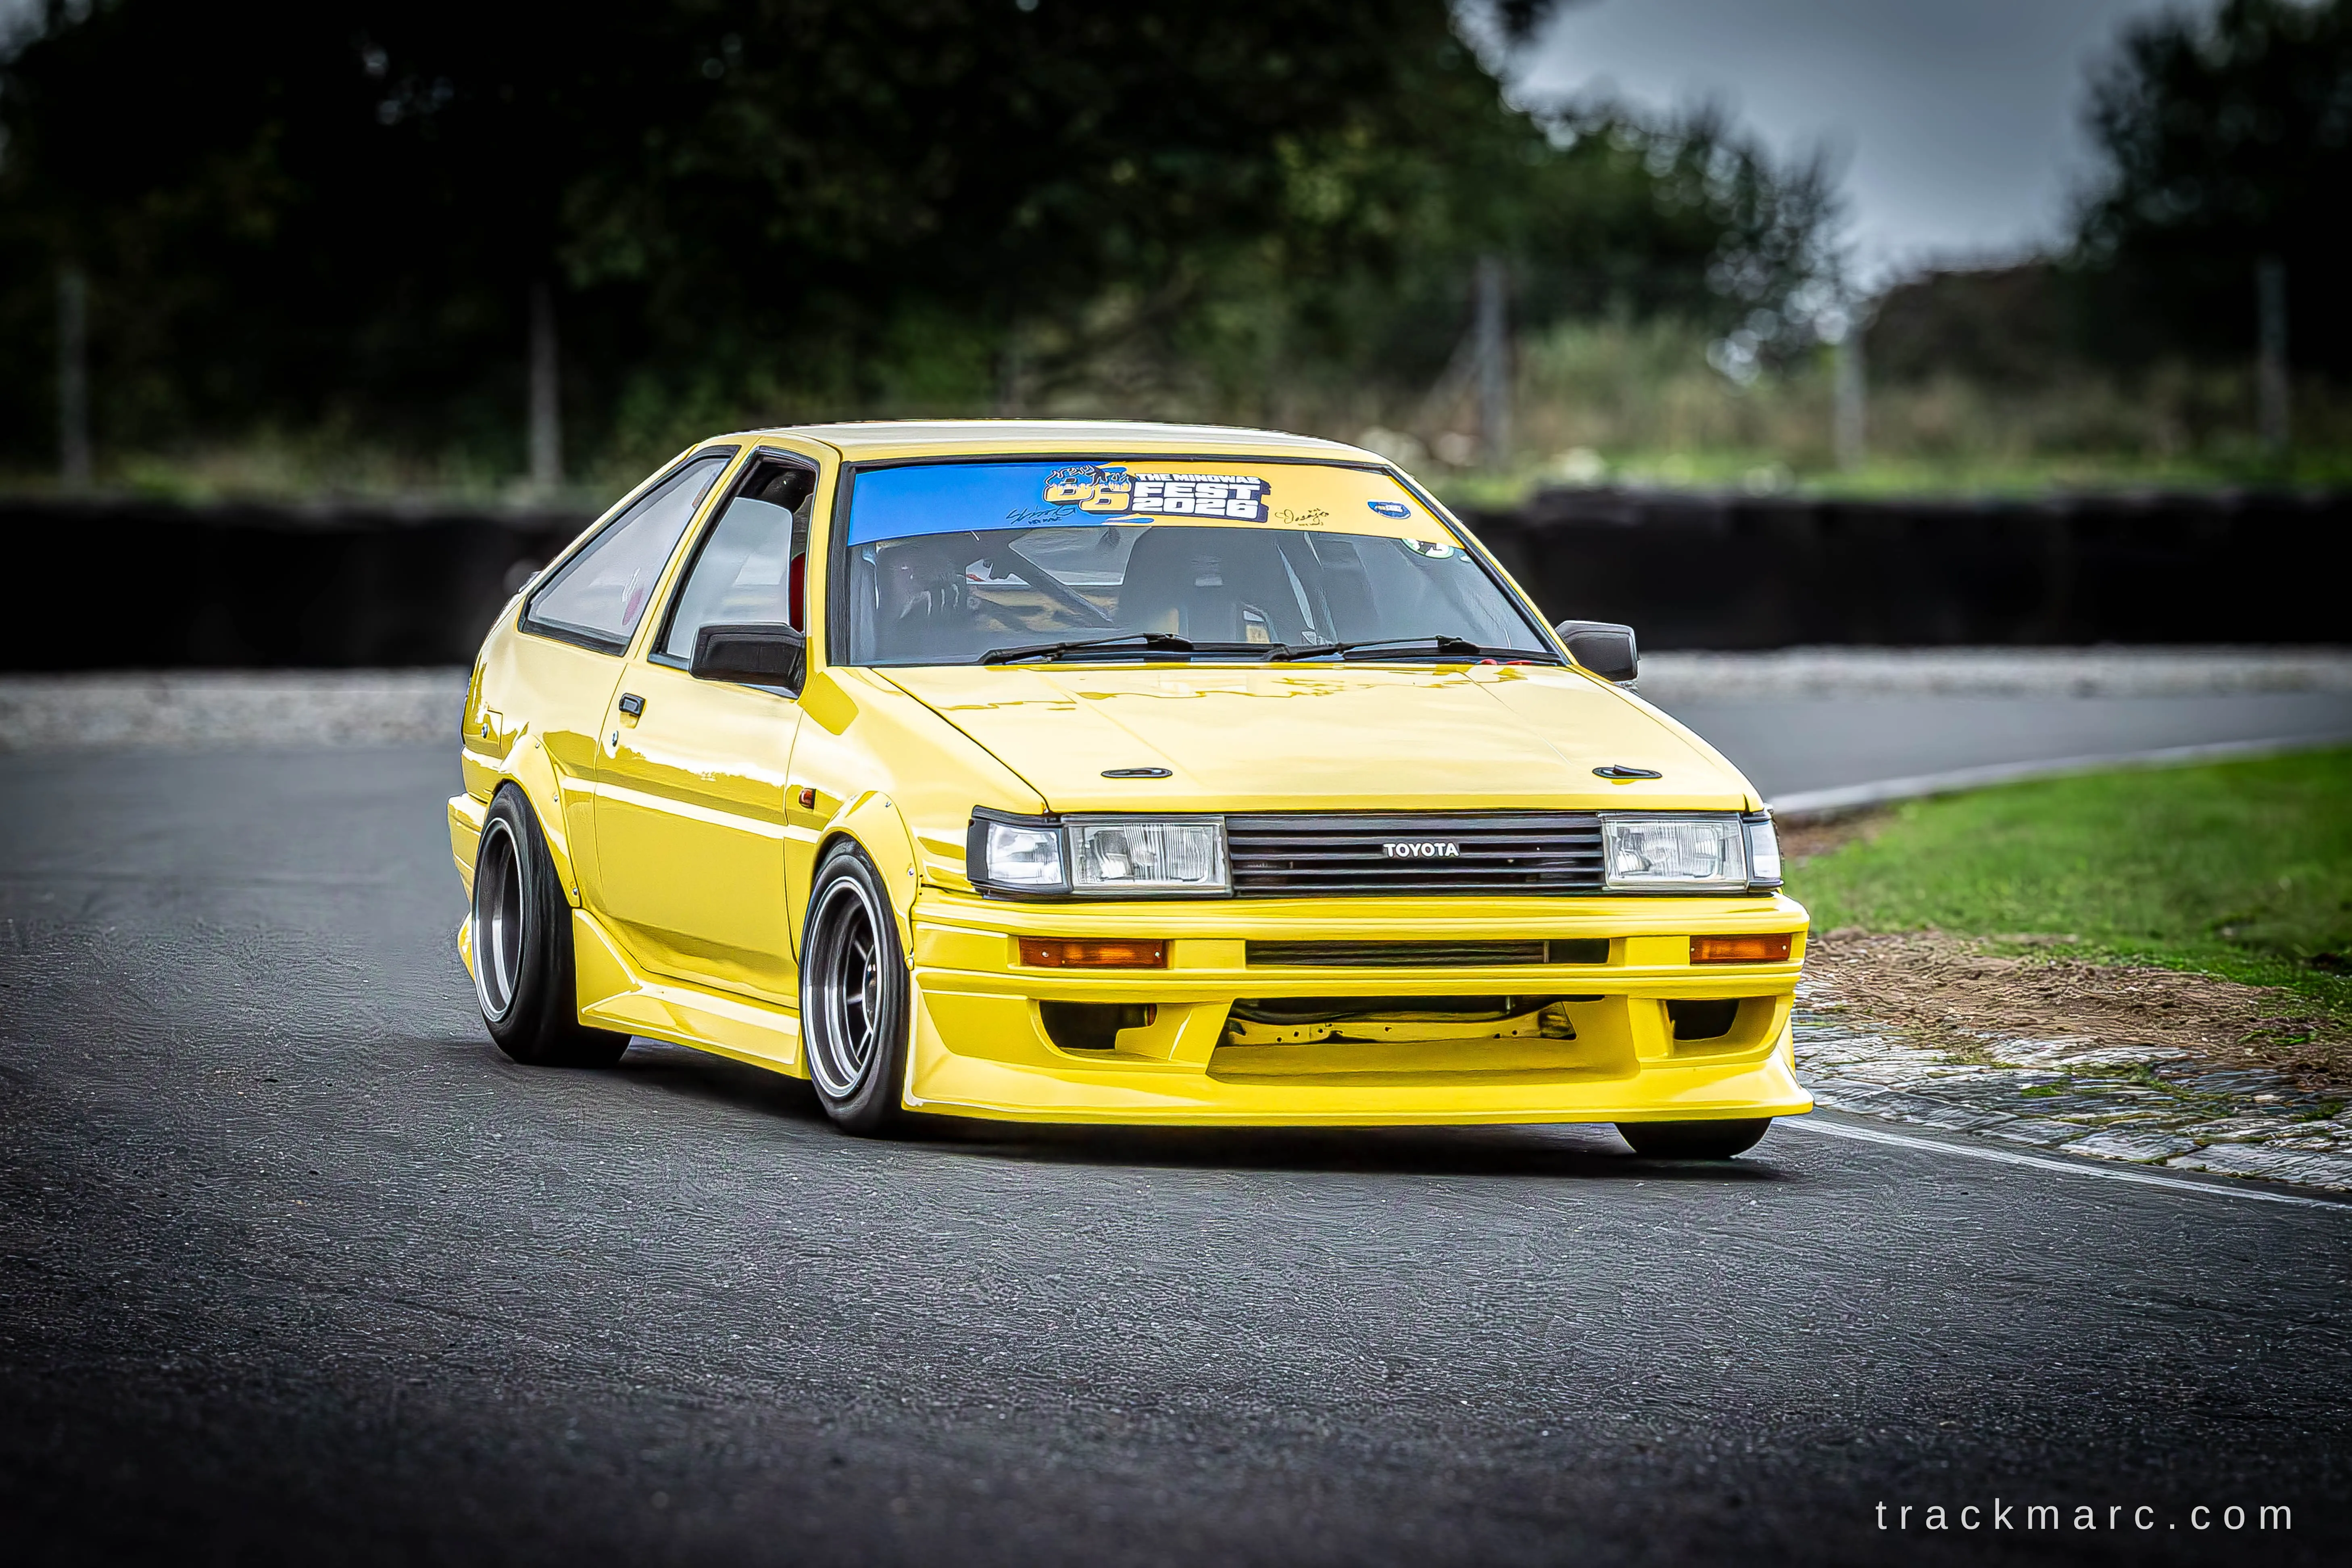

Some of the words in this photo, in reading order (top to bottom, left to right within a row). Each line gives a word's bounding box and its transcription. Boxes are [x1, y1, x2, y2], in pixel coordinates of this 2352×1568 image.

[1043, 465, 1131, 511] 86
[1135, 473, 1173, 481] THE
[1172, 473, 1261, 484] MINOWAS
[1133, 481, 1260, 500] FEST
[1131, 497, 1259, 520] 2026
[1383, 842, 1460, 857] TOYOTA
